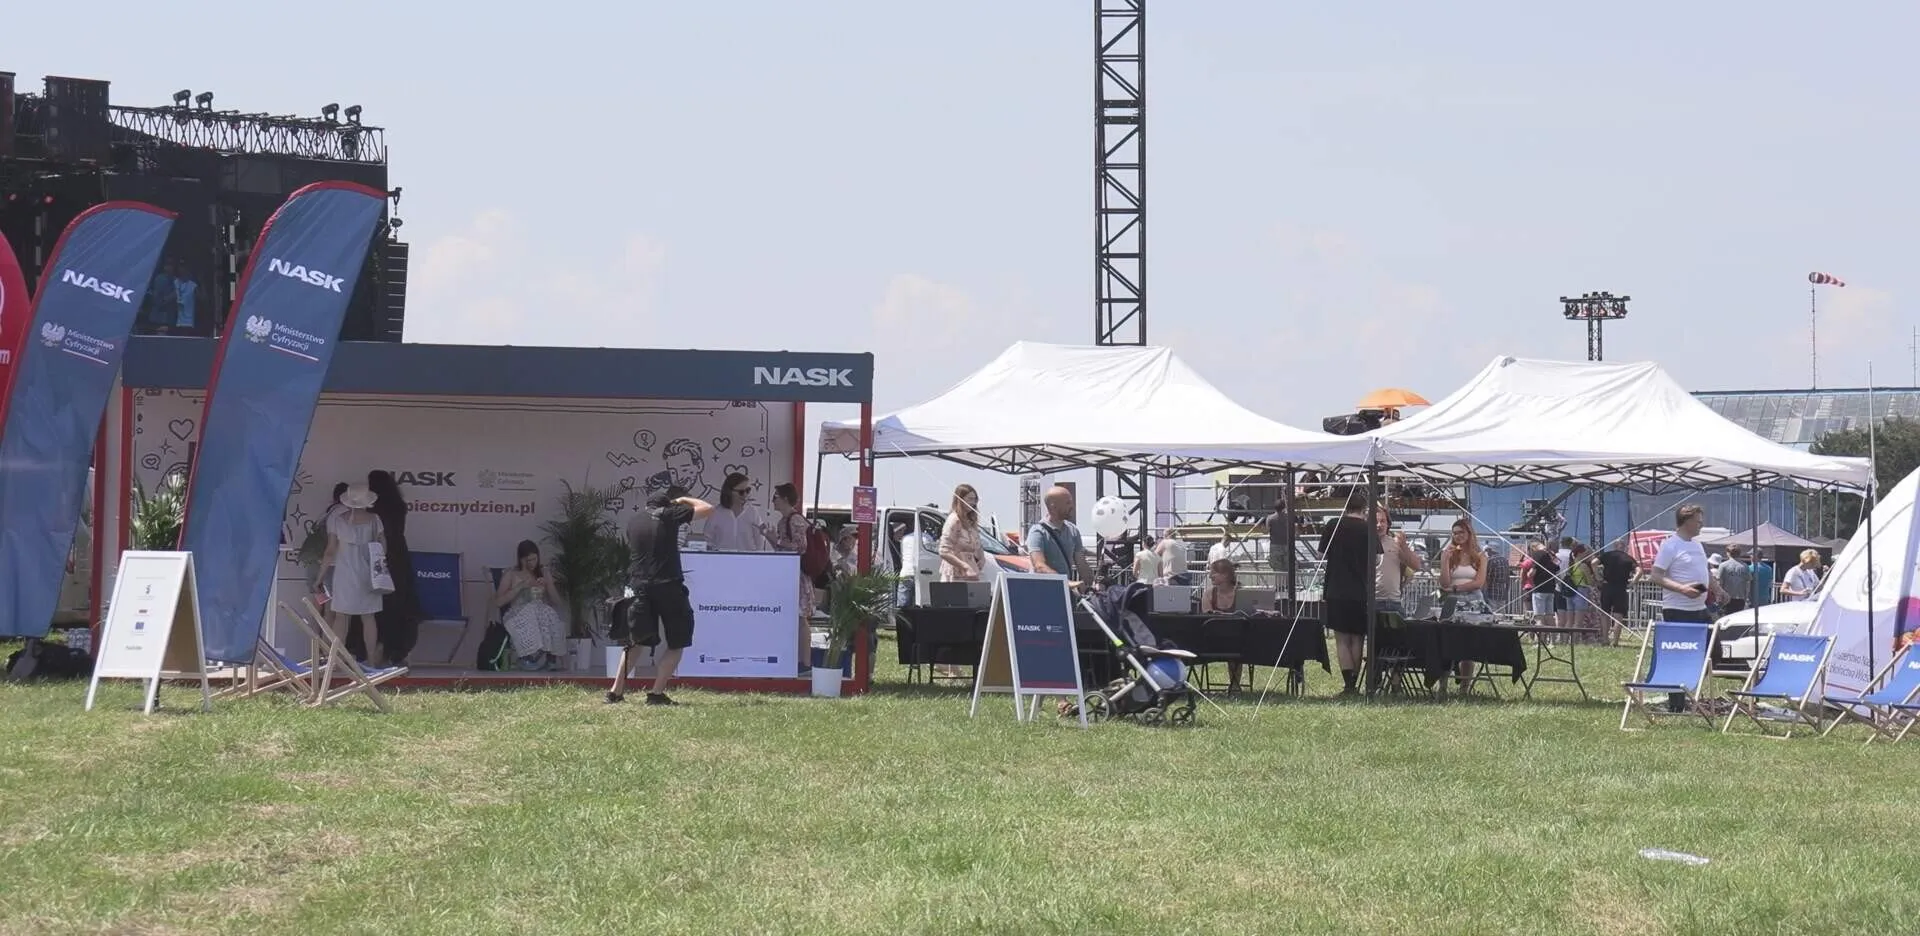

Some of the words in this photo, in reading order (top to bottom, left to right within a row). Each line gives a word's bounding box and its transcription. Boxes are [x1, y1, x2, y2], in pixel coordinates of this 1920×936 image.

[268, 258, 345, 293] NASK
[62, 269, 135, 303] NASK
[67, 329, 115, 350] Ministerstwo
[271, 333, 310, 351] Cyfryzacji
[274, 323, 325, 345] Ministerstwo
[753, 366, 854, 387] NASK
[405, 500, 536, 517] piecznydzien.pl
[417, 570, 451, 579] NASK
[698, 604, 782, 614] bezpiecznydzien.pl
[1661, 641, 1699, 650] NASK
[1778, 652, 1816, 662] NASK
